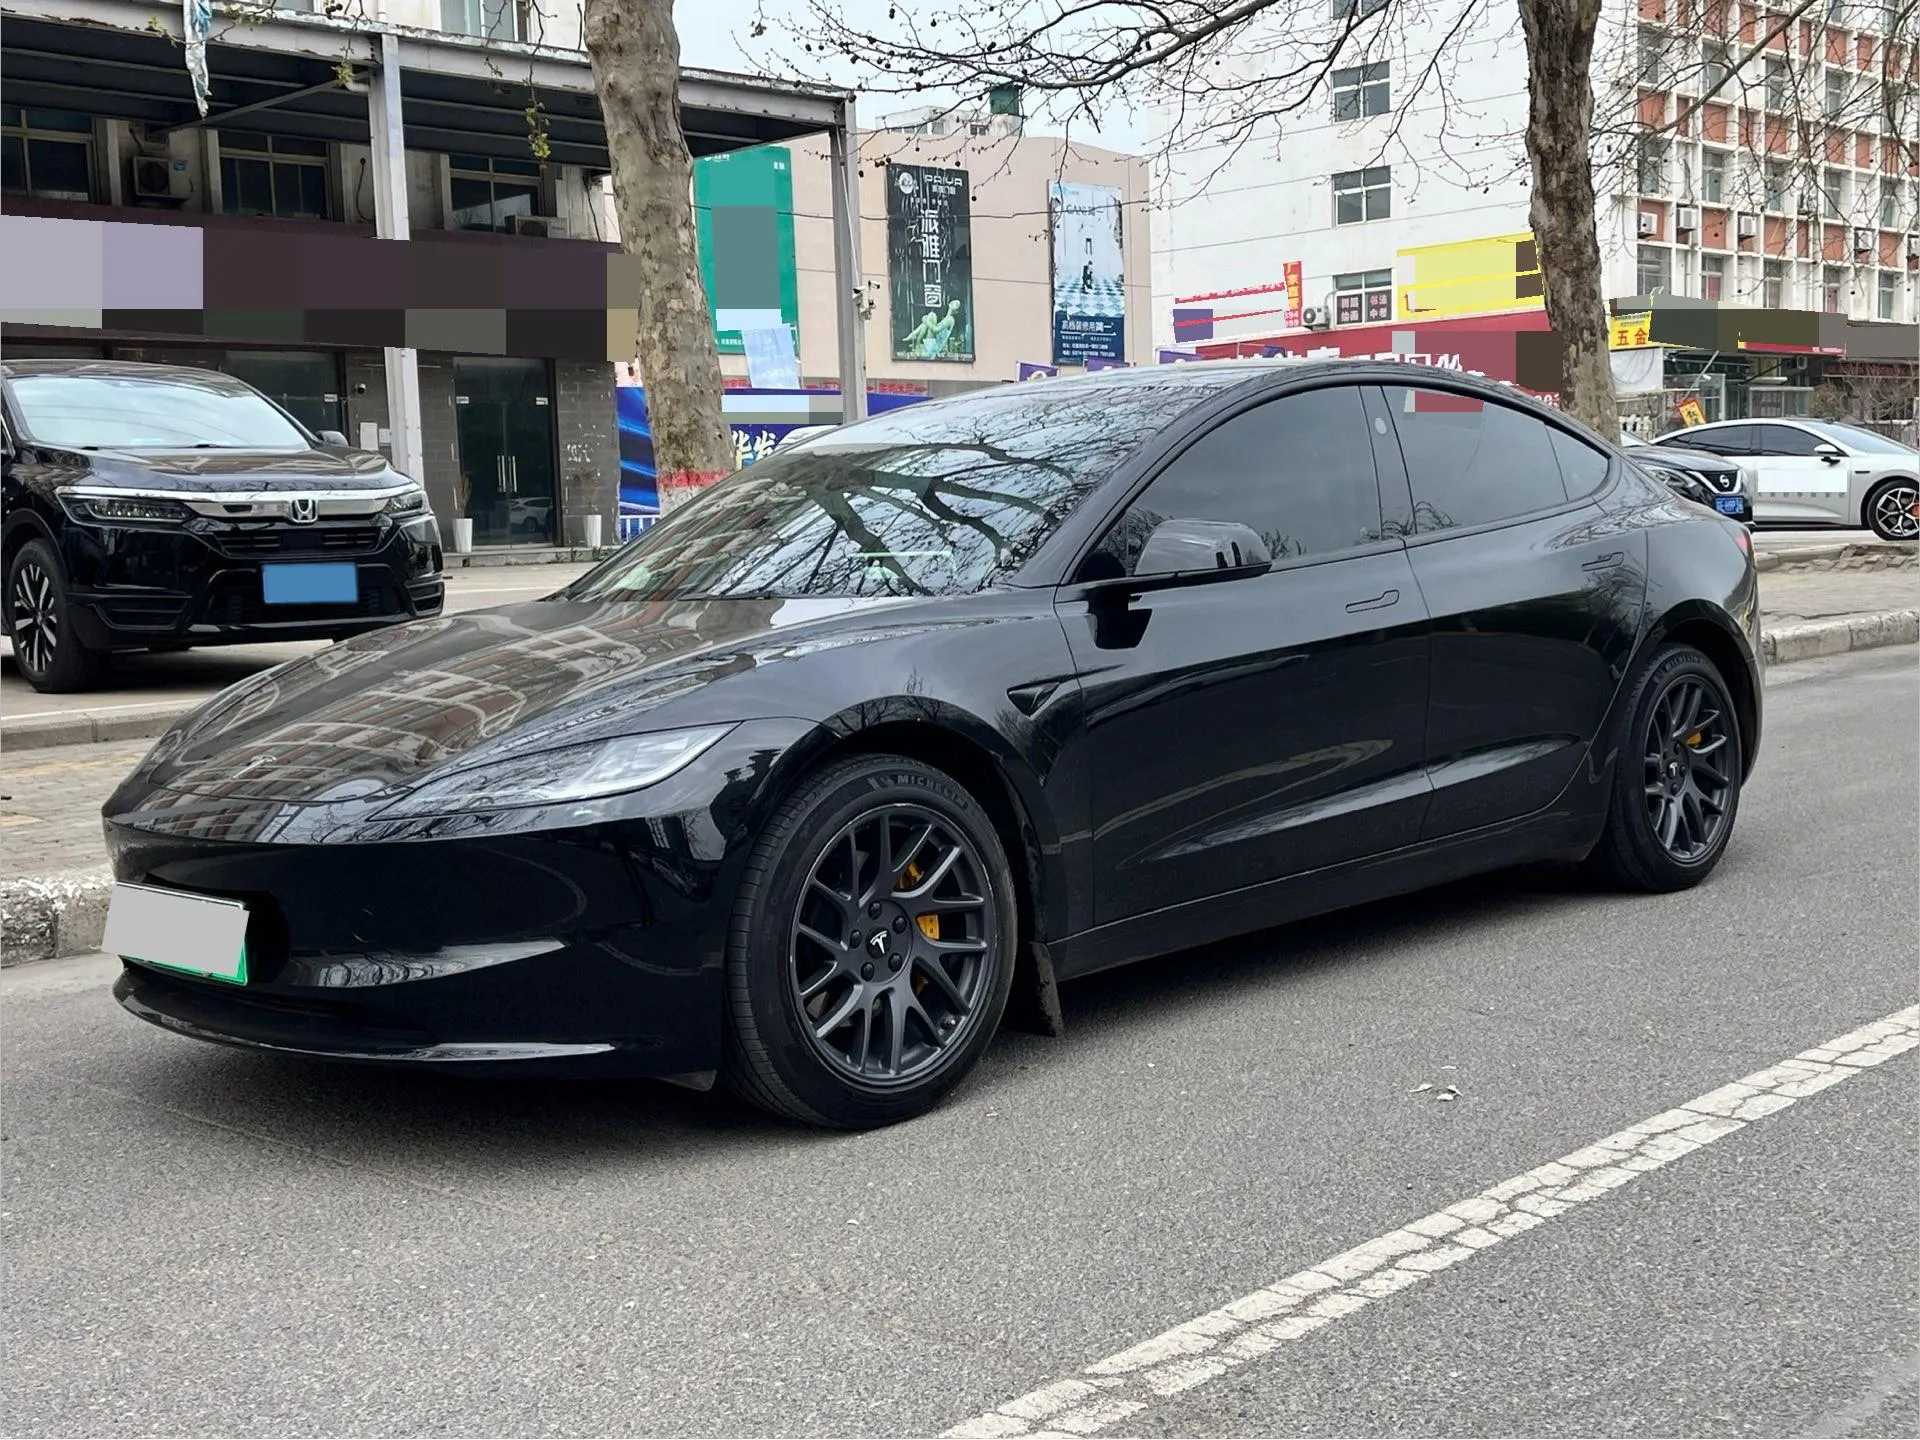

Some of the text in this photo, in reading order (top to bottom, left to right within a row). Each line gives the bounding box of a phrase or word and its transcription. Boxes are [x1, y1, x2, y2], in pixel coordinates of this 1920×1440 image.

[920, 209, 942, 308] 派雅门窗
[1616, 327, 1648, 346] 五金
